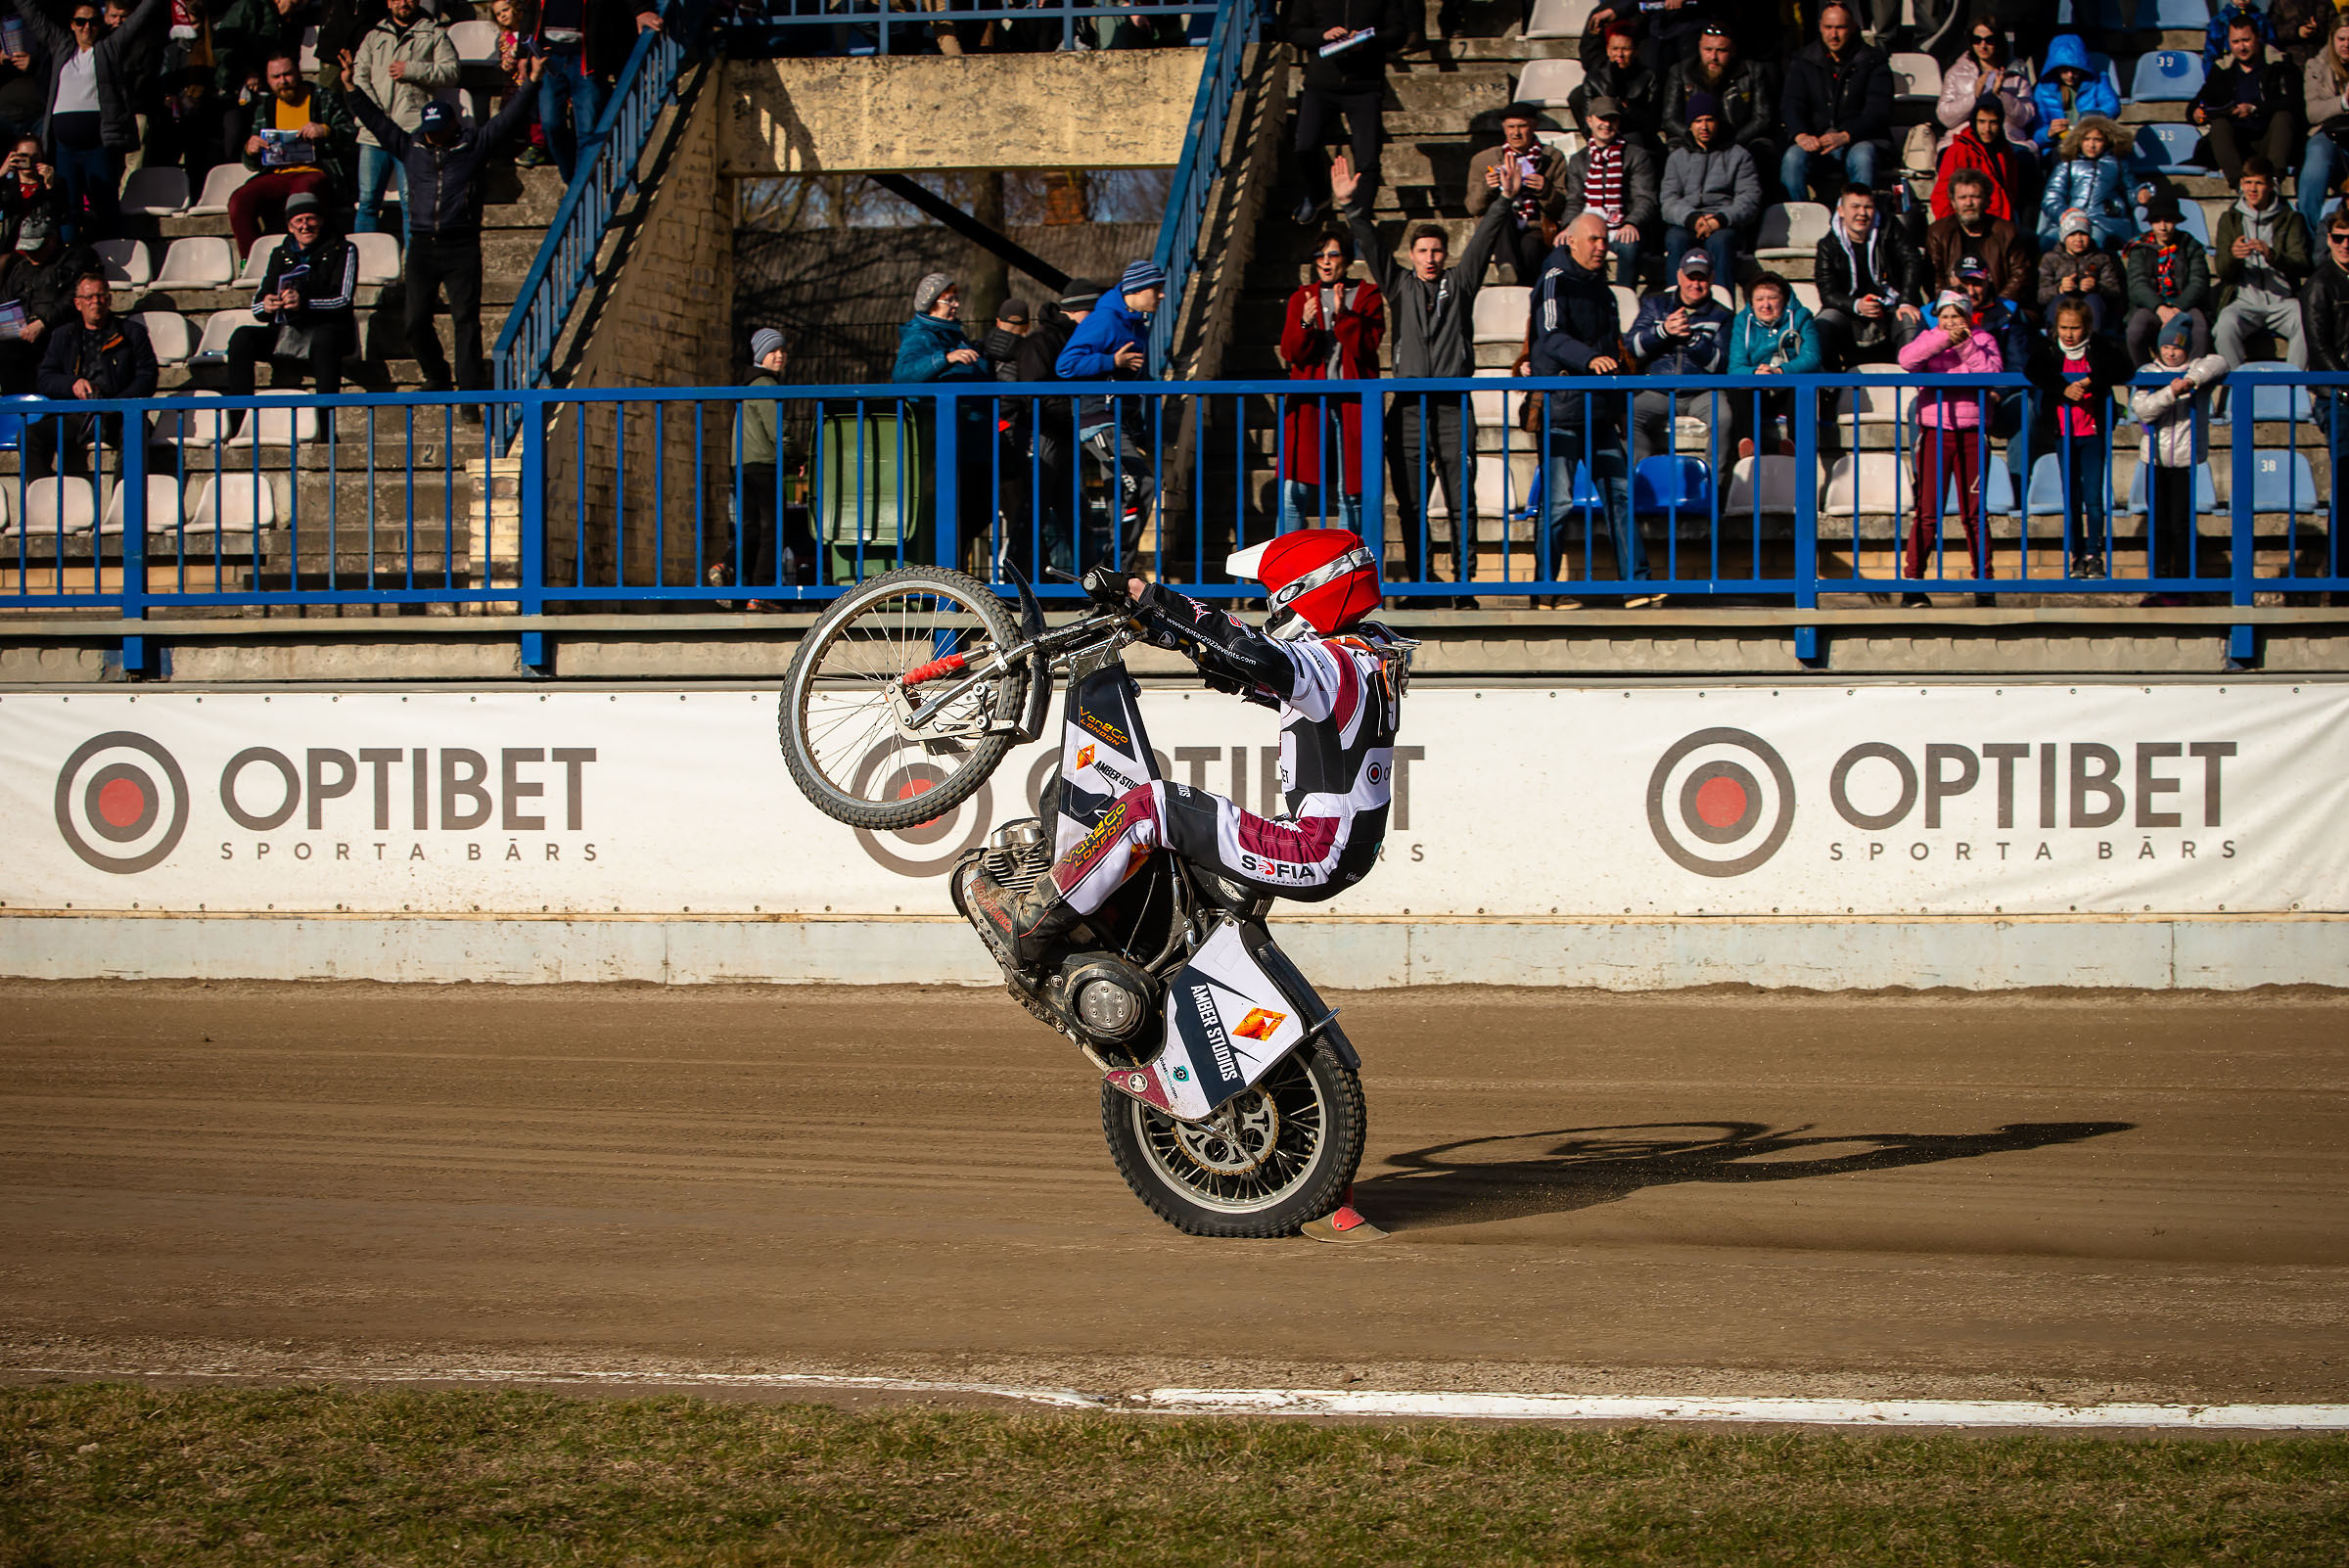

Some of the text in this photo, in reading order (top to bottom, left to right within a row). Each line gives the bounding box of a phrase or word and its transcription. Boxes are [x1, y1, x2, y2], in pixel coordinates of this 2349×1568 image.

[2157, 56, 2175, 68] 39
[423, 443, 436, 463] 2
[2261, 459, 2277, 472] 38
[1093, 760, 1123, 782] AMBER
[220, 747, 596, 831] OPTIBET
[1830, 742, 2236, 830] OPTIBET
[221, 838, 596, 861] SPORTA BĀRS
[1074, 816, 1123, 868] LONDON
[1830, 835, 2235, 860] SPORTA BĀRS
[1190, 984, 1238, 1082] AMBER STUDIOS
